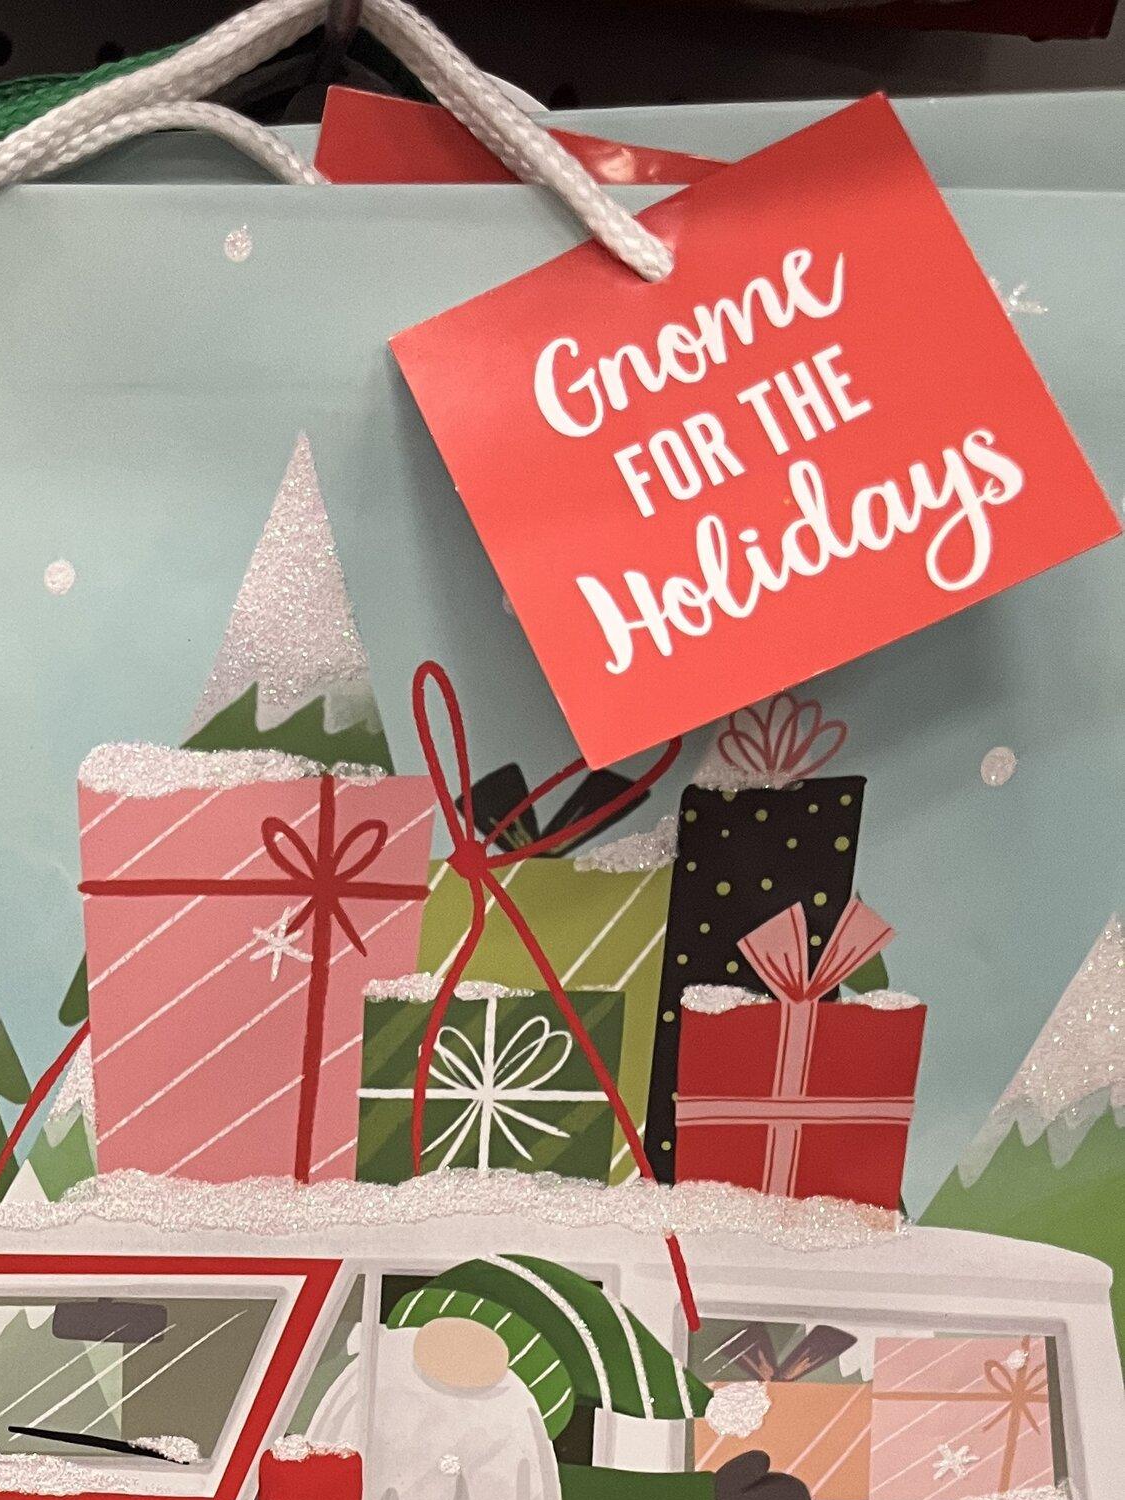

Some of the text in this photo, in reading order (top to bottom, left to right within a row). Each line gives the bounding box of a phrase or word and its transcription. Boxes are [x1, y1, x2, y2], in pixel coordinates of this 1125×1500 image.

[534, 246, 846, 438] Gnome
[613, 343, 874, 518] FOR THE
[575, 428, 1025, 674] Holidays
